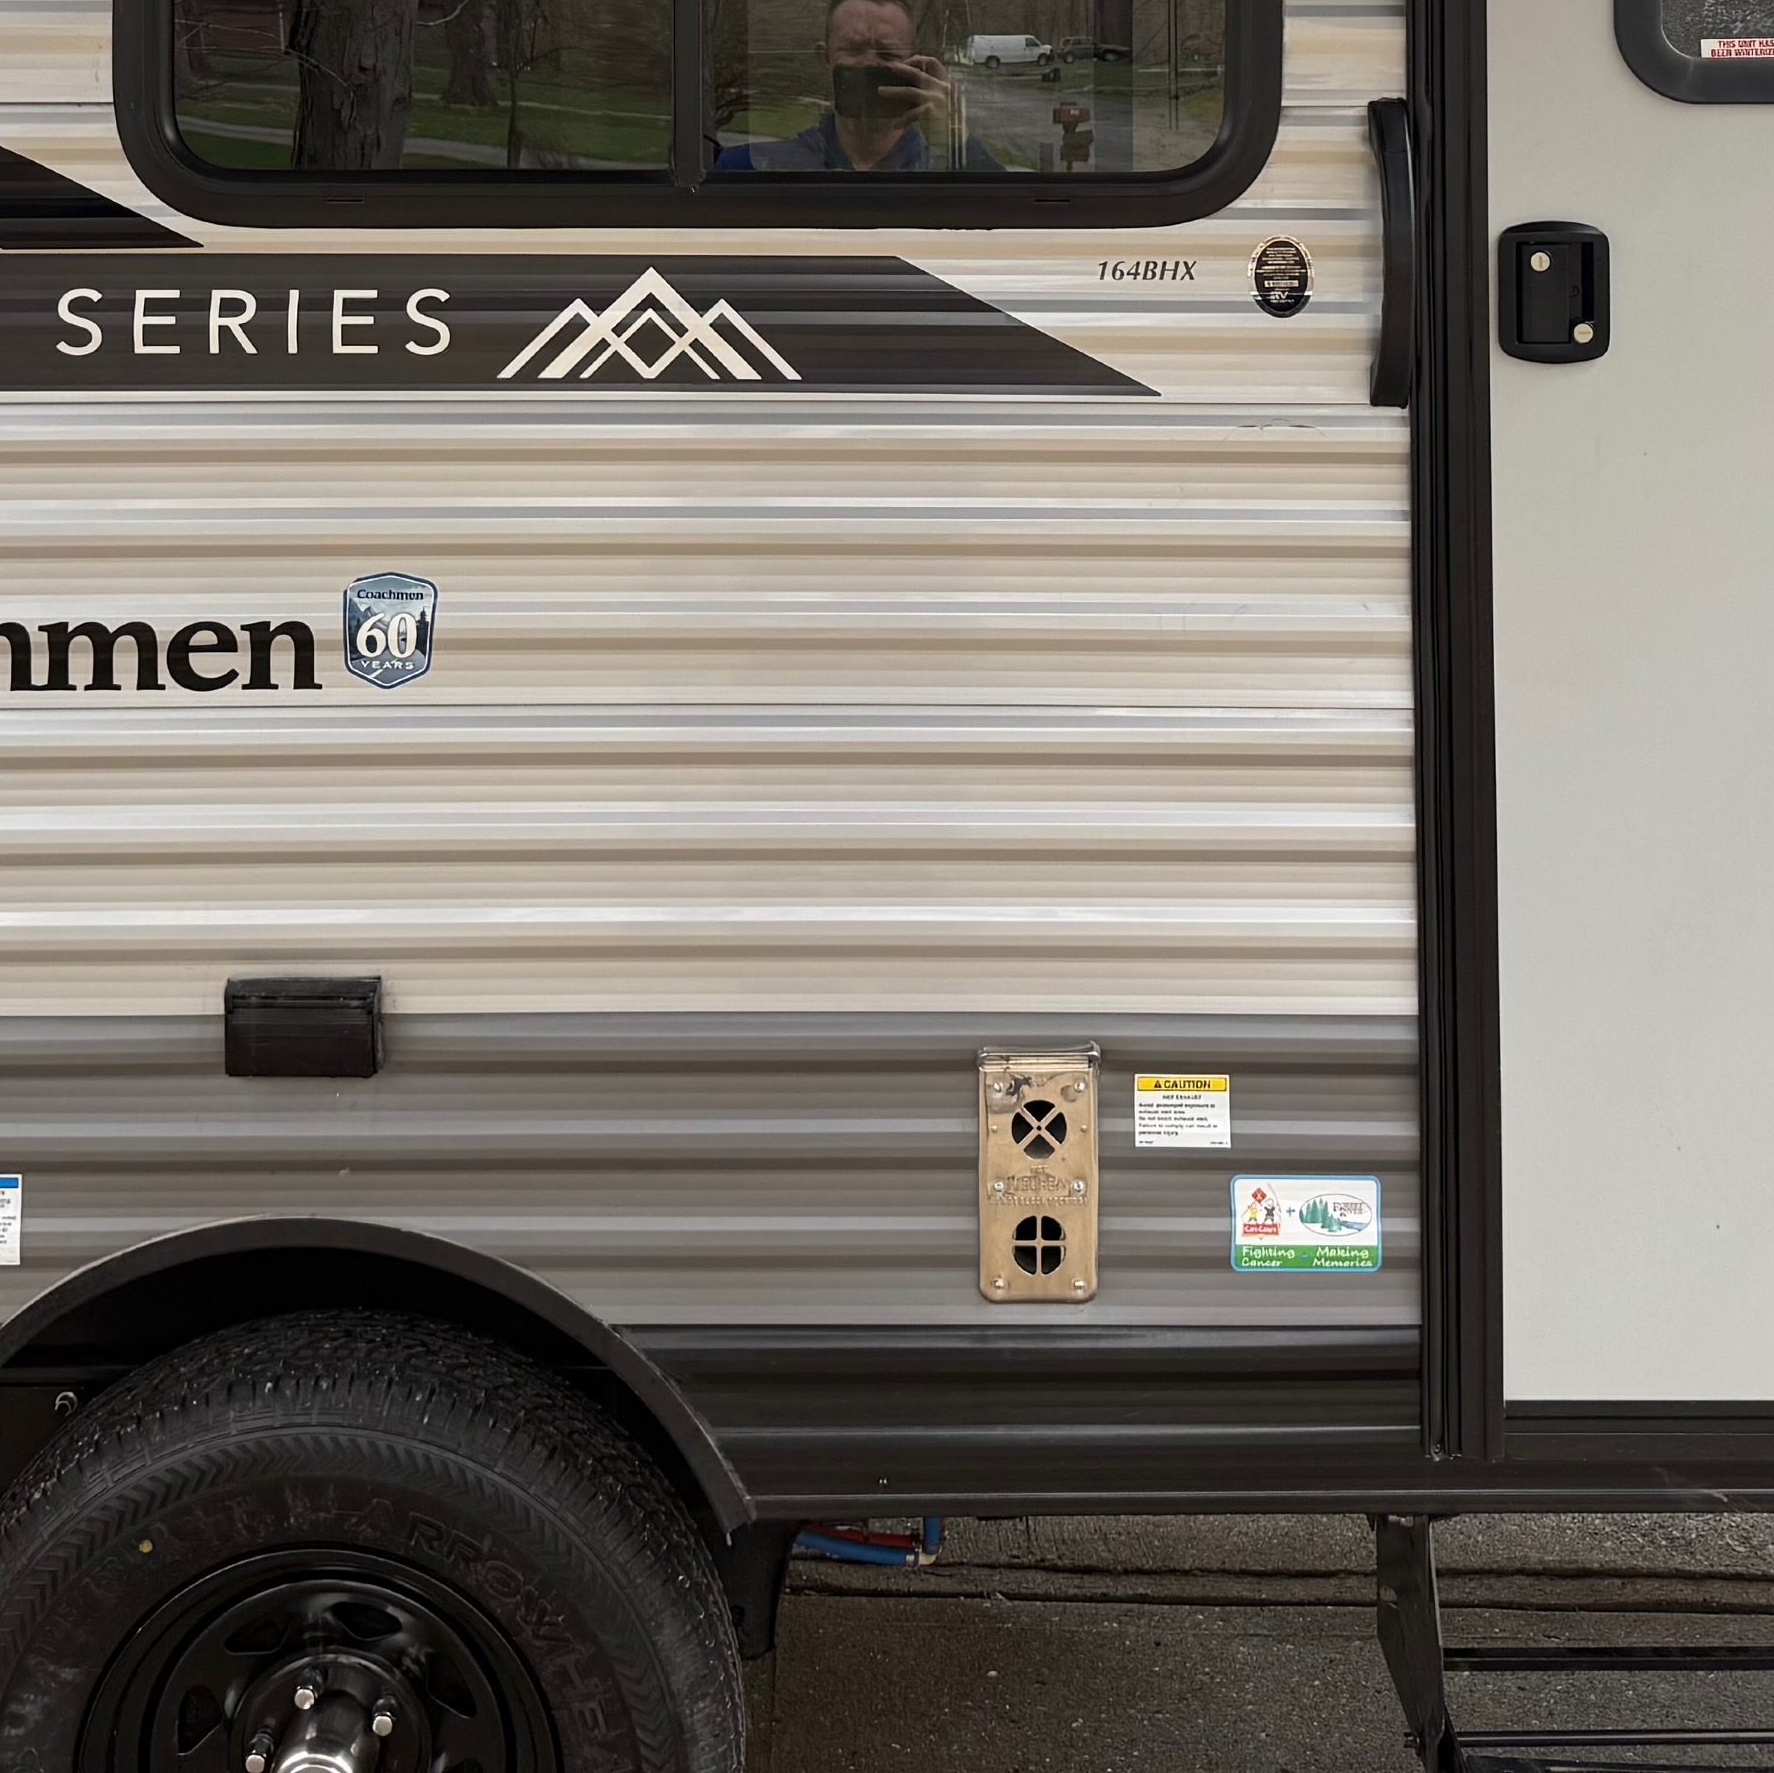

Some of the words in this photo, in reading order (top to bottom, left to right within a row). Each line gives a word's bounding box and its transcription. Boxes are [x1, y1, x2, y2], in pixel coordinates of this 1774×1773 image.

[1711, 49, 1732, 57] BEEN
[1098, 261, 1197, 280] 164BHX
[56, 288, 451, 357] SERIES
[357, 589, 424, 600] Coachmen
[356, 613, 418, 659] 60
[361, 660, 414, 670] YEARS
[1164, 1080, 1211, 1089] CAUTION
[1242, 1246, 1295, 1257] Fighting
[1316, 1246, 1369, 1257] Making
[1242, 1257, 1283, 1267] Cancer
[1313, 1258, 1373, 1267] Memories
